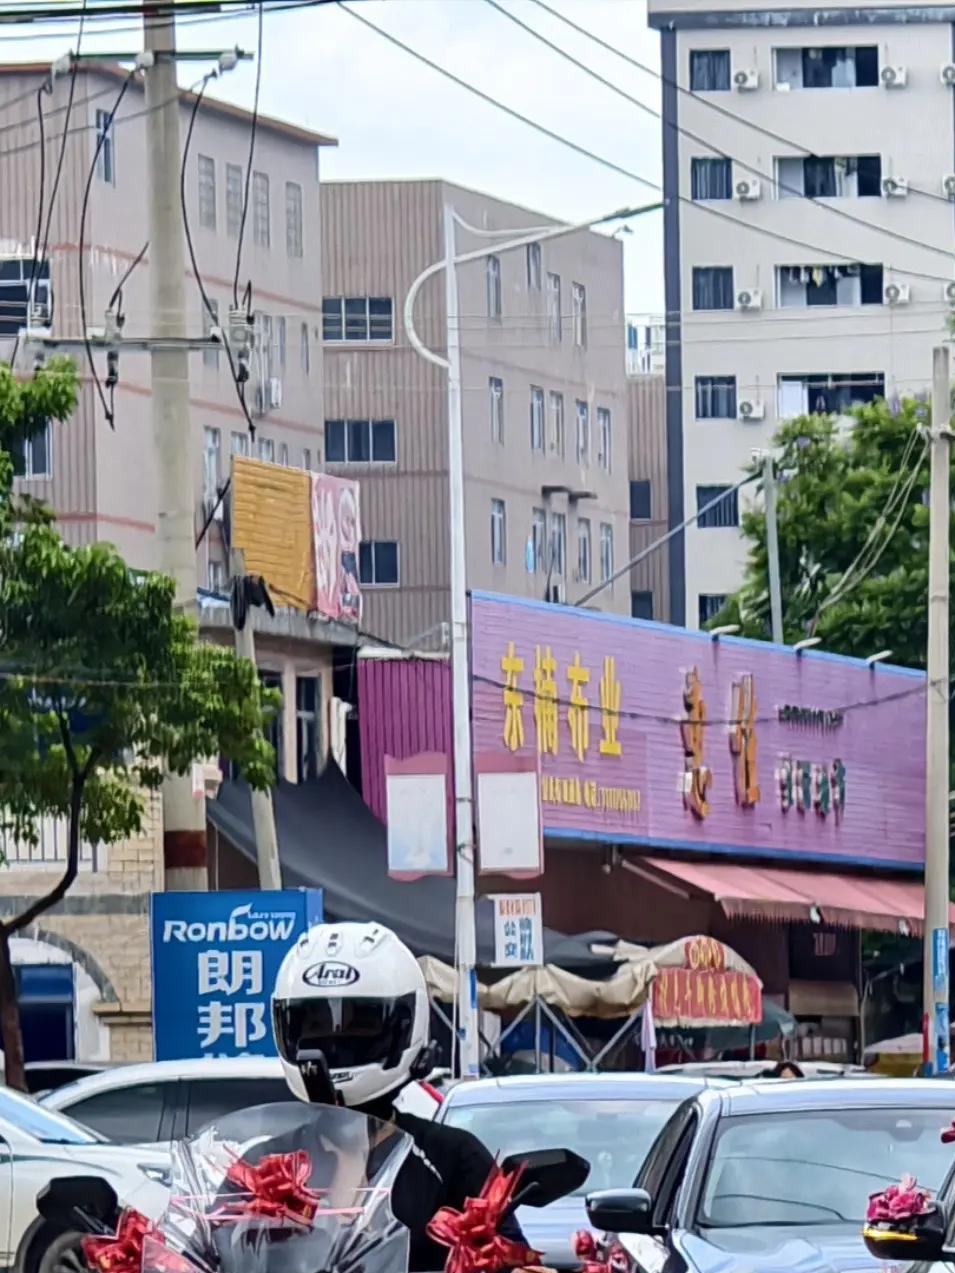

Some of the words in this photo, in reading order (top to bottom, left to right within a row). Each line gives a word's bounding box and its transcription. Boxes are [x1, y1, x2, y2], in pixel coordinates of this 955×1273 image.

[163, 903, 297, 943] Ronbow
[305, 962, 354, 981] Arai
[197, 949, 267, 1058] 朗邦
